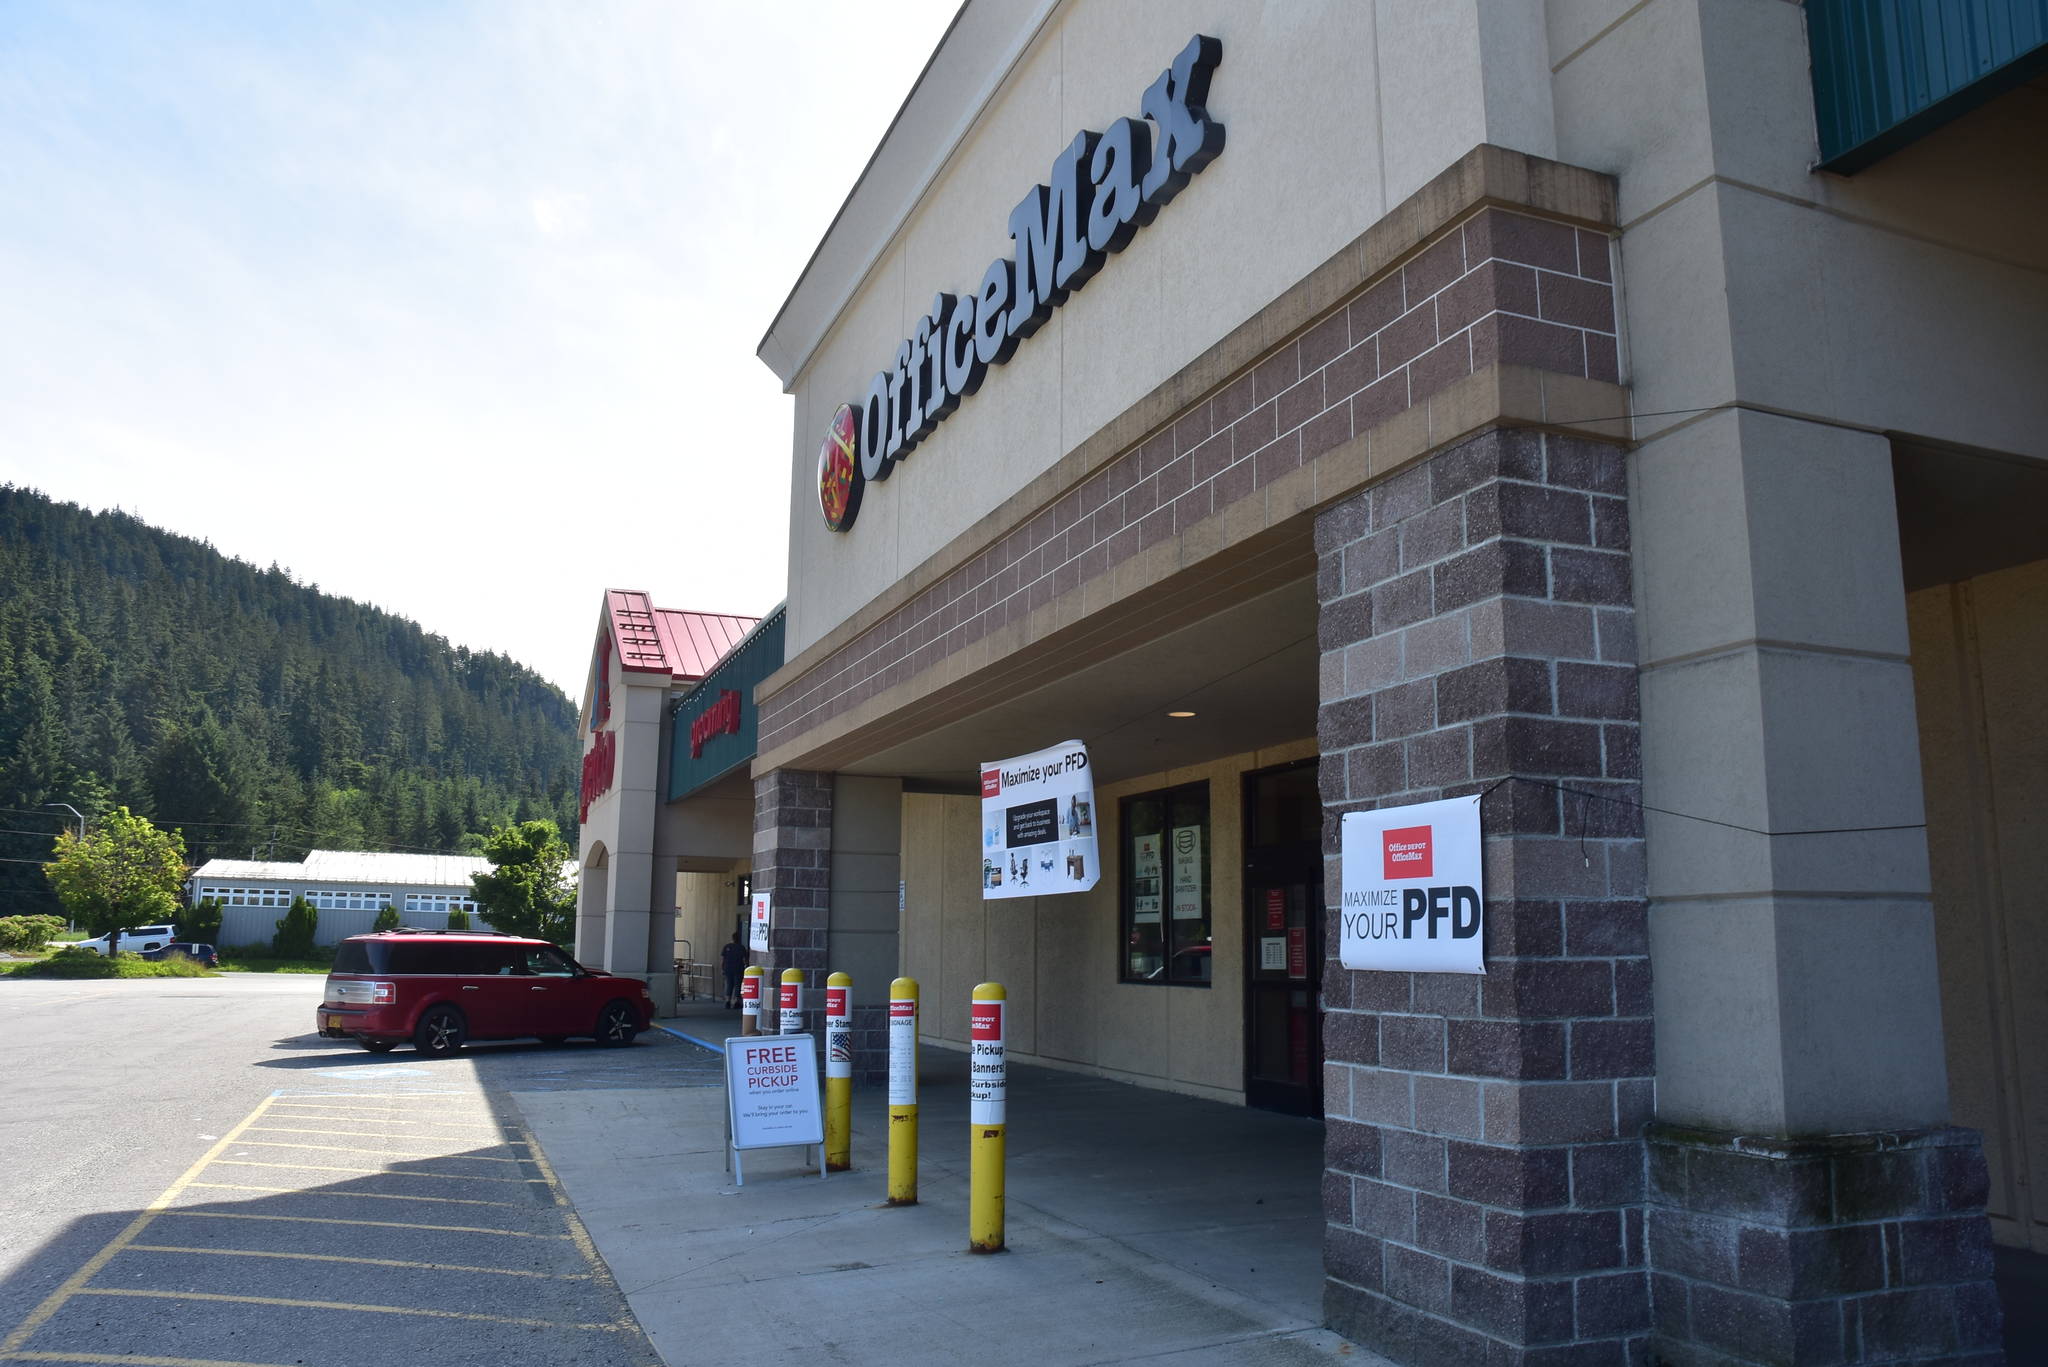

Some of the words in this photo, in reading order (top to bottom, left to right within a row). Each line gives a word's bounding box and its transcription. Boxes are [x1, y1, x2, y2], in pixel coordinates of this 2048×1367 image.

[861, 33, 1226, 481] OfficeMax
[1001, 766, 1040, 788] Maximize
[1043, 761, 1063, 784] your
[1066, 752, 1087, 773] PFD
[1389, 843, 1407, 852] Office
[1408, 842, 1426, 850] DEPOT
[1392, 852, 1422, 862] OfficeMax
[1344, 889, 1398, 907] MAXIMIZE
[1344, 913, 1398, 940] YOUR
[1402, 885, 1481, 940] PFD
[746, 1046, 797, 1065] FREE
[977, 1044, 1003, 1058] Pickup
[747, 1064, 798, 1076] CURBSIDE
[748, 1075, 799, 1088] PICKUP
